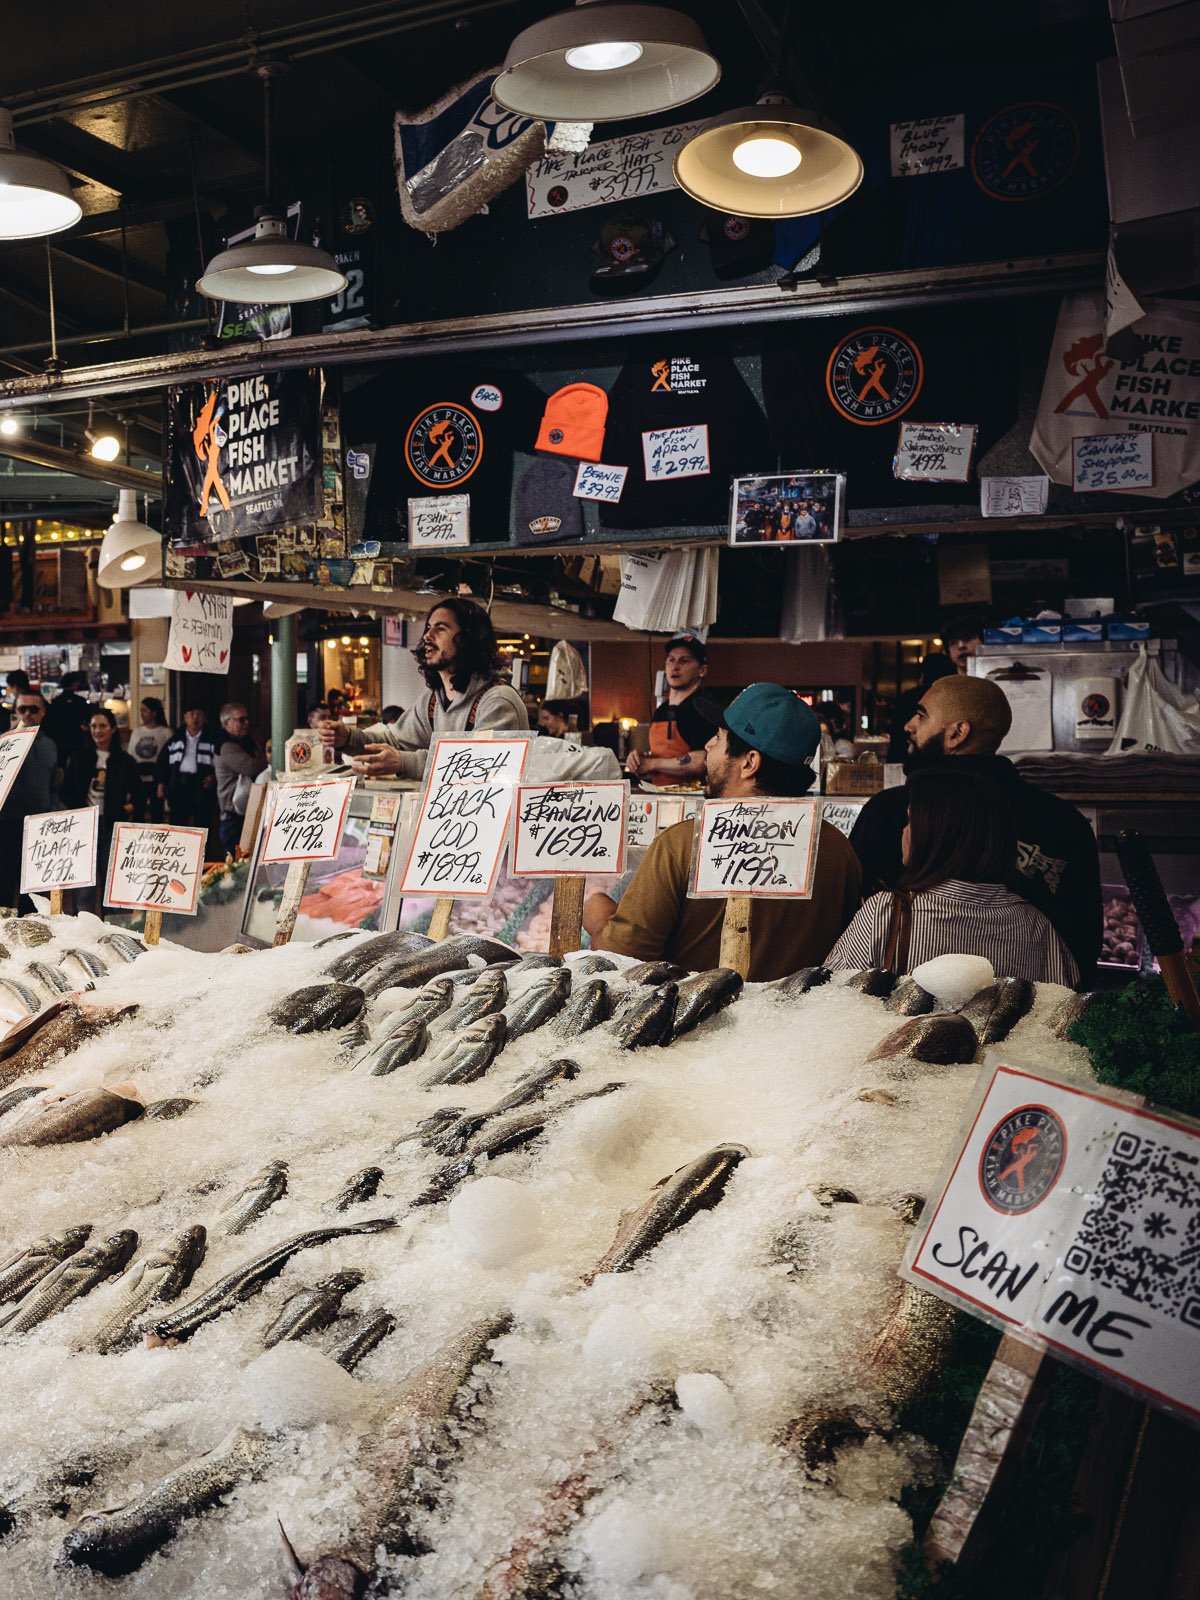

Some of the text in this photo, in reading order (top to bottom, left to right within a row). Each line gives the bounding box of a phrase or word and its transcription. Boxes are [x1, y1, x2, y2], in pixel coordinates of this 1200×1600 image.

[902, 128, 946, 143] BLUE
[535, 157, 566, 178] PIKE
[574, 147, 613, 168] PLACE
[616, 138, 656, 155] FISH
[553, 151, 665, 181] TRUCKER HATS
[335, 250, 360, 265] RAKEN
[671, 357, 691, 365] PIKE
[837, 335, 911, 369] PIKE PLACE
[671, 364, 700, 373] PLACE
[671, 372, 691, 381] FISH
[227, 375, 265, 410] PIKE
[475, 388, 500, 402] BACK
[671, 379, 707, 388] MARKET
[1120, 374, 1177, 396] FISH
[837, 381, 912, 416] FISH MARKET
[228, 399, 280, 438] PLACE
[415, 410, 477, 441] PIKE PLACE
[228, 434, 266, 468] FISH
[652, 438, 700, 458] APRON
[1077, 443, 1138, 457] CANVAS
[229, 456, 299, 498] MARKET
[413, 451, 474, 480] FISH MARKET
[582, 465, 624, 483] BEANIE
[437, 748, 511, 785] FRESH
[427, 784, 505, 820] BLACK
[520, 802, 621, 823] BRANZINO
[274, 807, 334, 827] LING COD
[707, 813, 806, 843] RAINBOW
[429, 819, 478, 849] COD
[28, 837, 88, 862] TILAPIA
[124, 841, 187, 858] ATLANTIC
[714, 842, 794, 858] TROUT
[417, 851, 482, 887] $18.99
[1001, 1114, 1060, 1161] PIKE PLACE
[985, 1153, 1001, 1191] FISH
[931, 1225, 1153, 1358] SCAN ME
